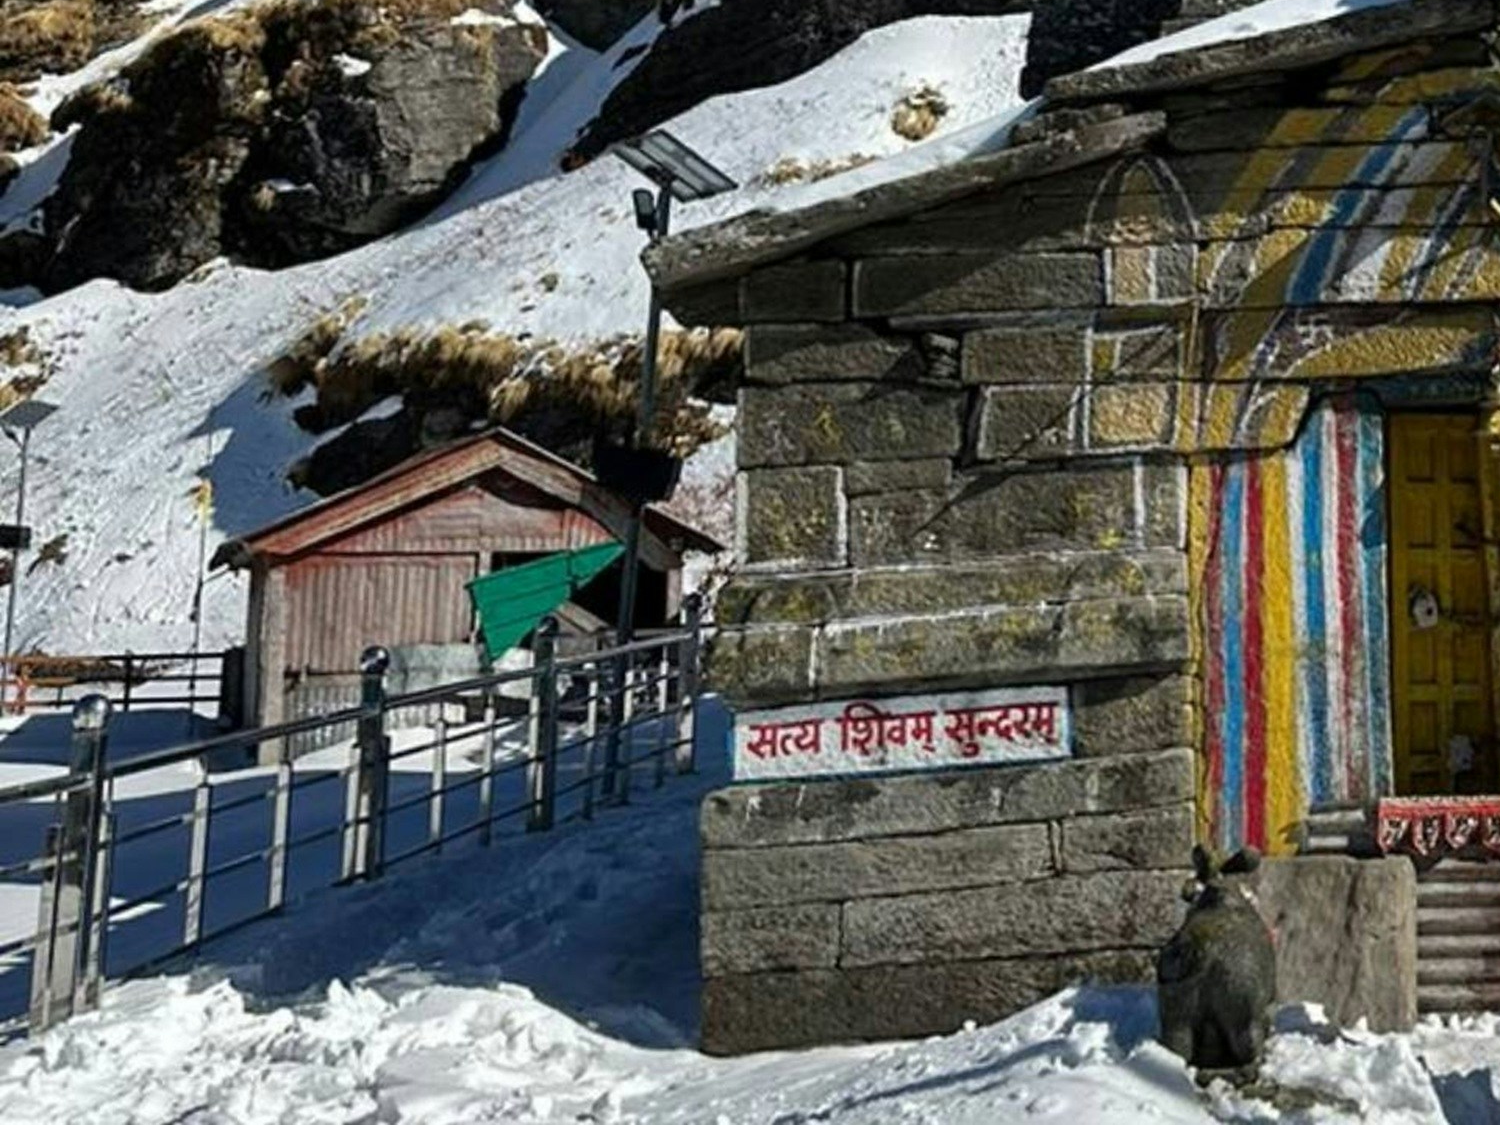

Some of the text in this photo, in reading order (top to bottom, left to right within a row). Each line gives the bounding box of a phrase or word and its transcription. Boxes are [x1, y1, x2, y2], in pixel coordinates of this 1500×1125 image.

[746, 701, 1059, 759] सत्य शिवम् सुन्दरम्
